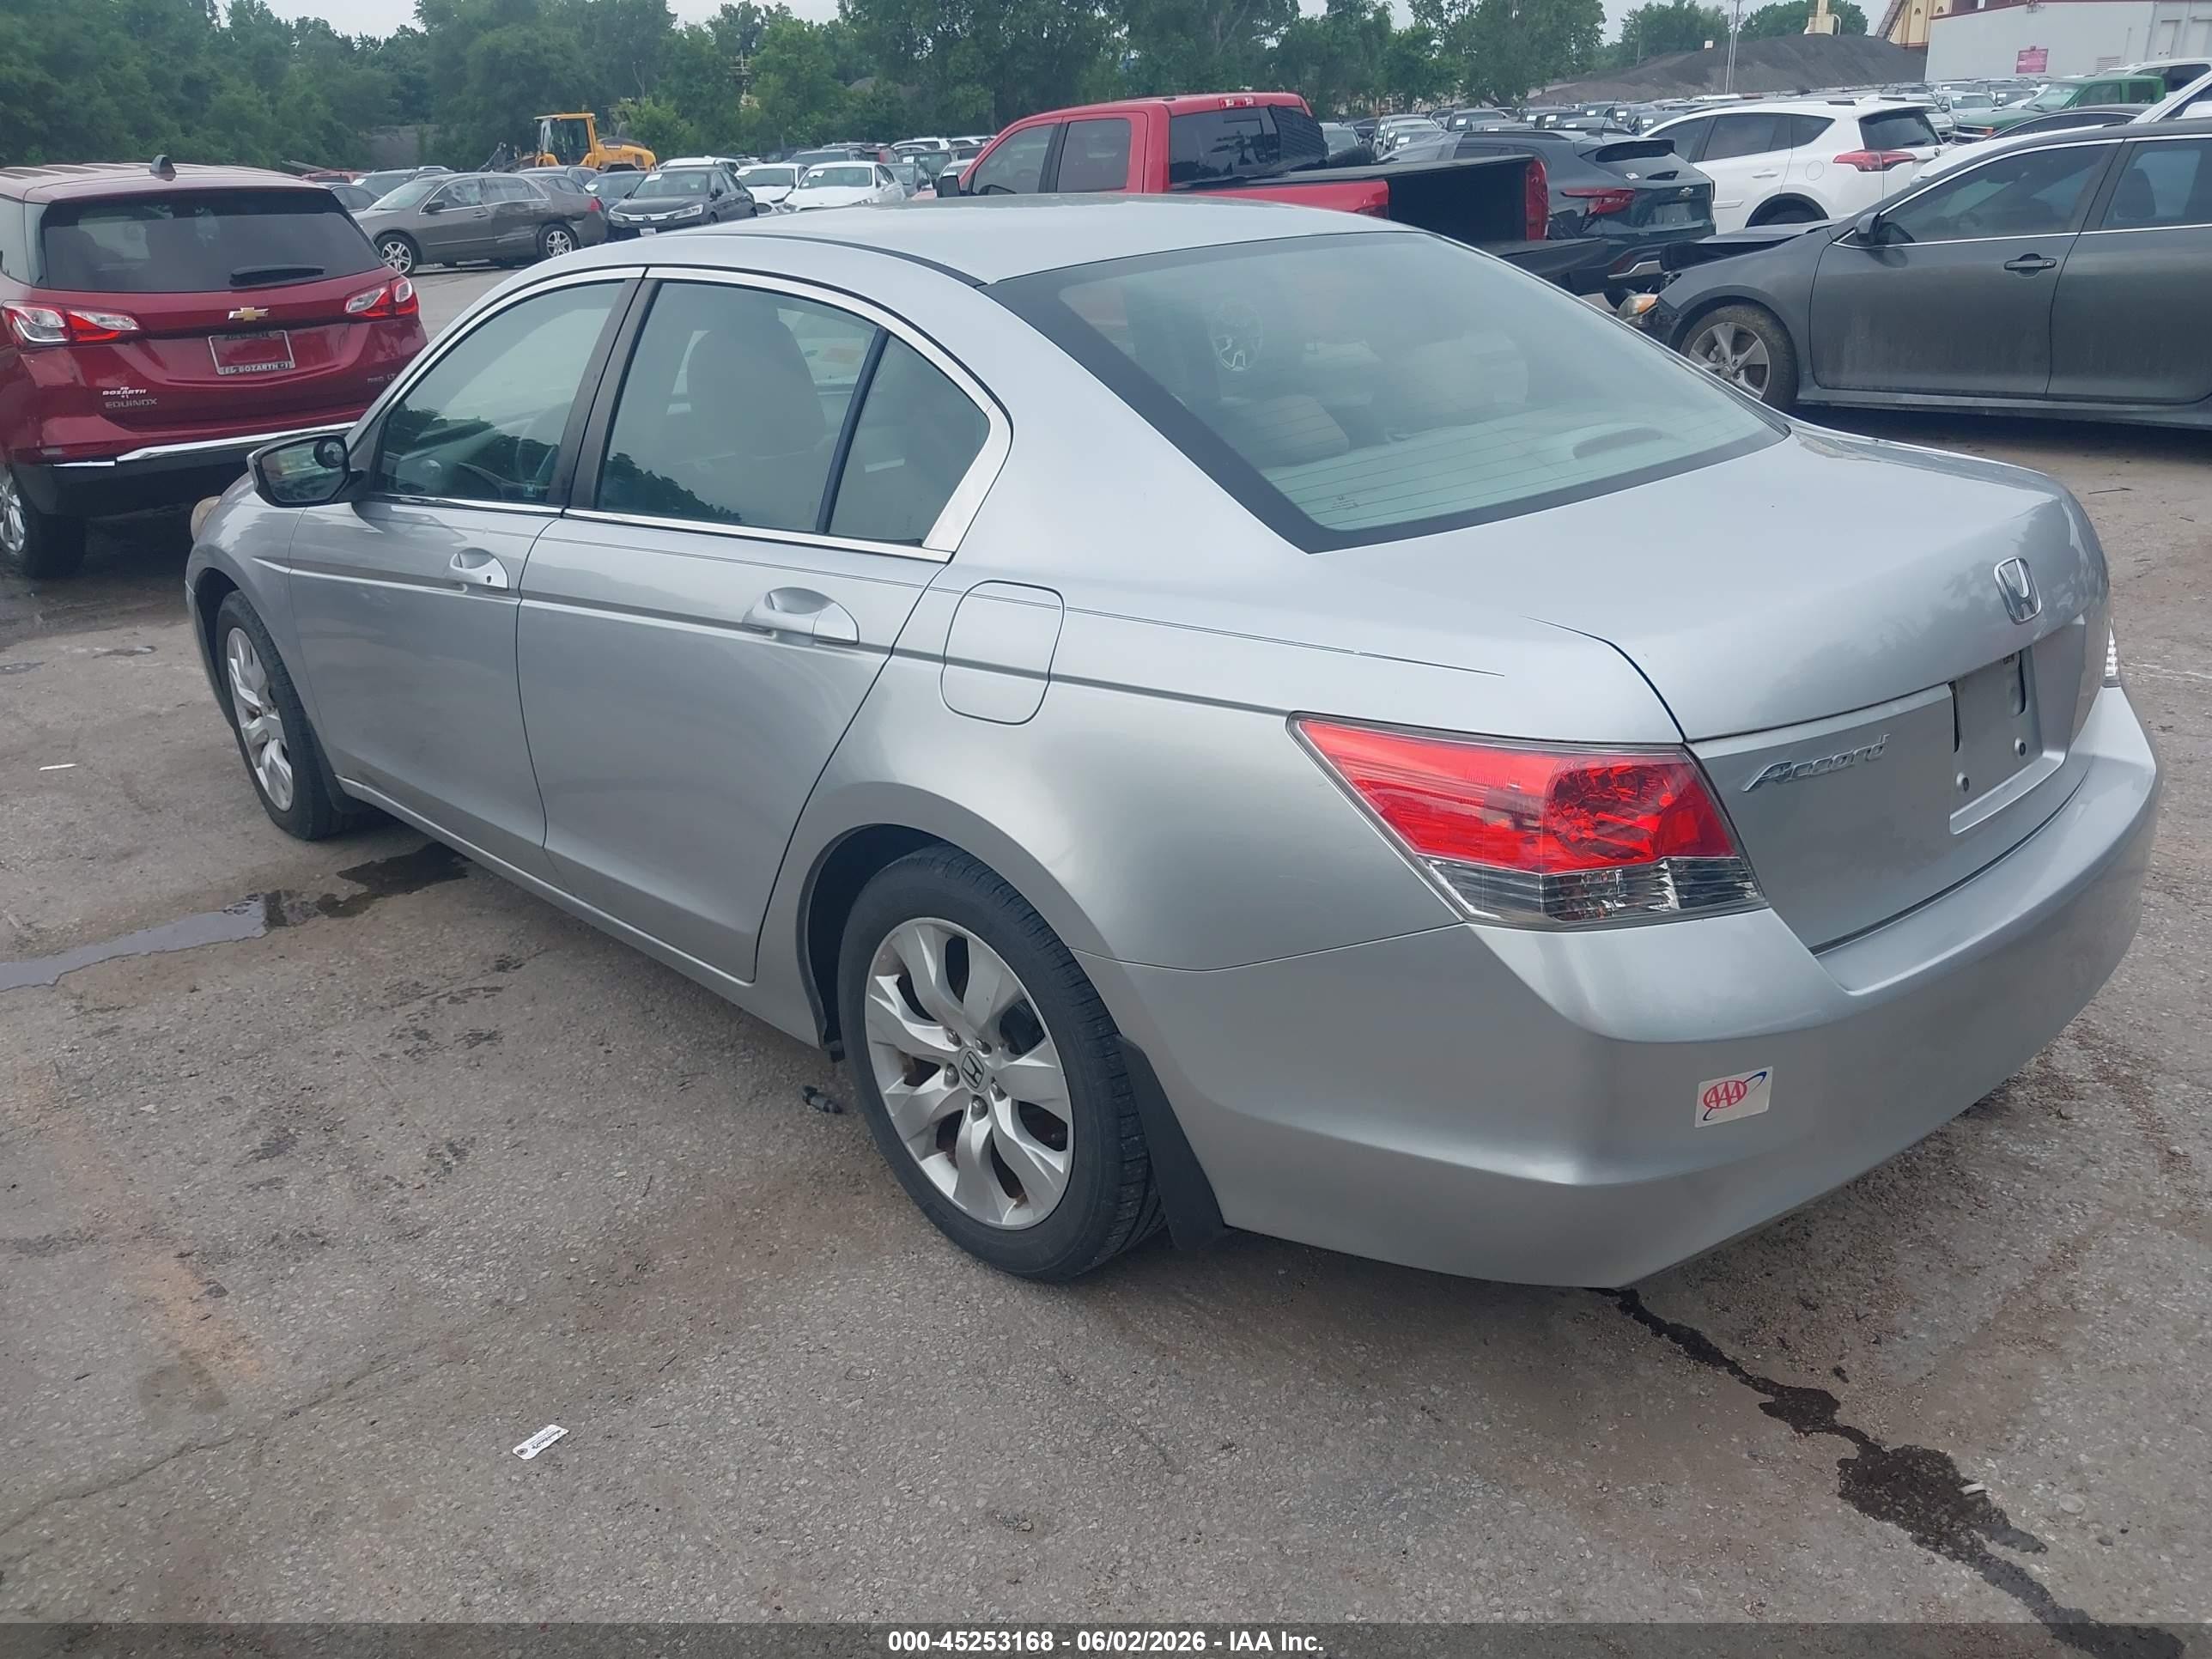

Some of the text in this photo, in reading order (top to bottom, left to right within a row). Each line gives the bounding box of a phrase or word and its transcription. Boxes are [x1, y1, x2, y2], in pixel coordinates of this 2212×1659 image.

[105, 398, 157, 409] EQUINOX
[1741, 734, 1890, 793] Accord
[1705, 1081, 1744, 1108] AAA
